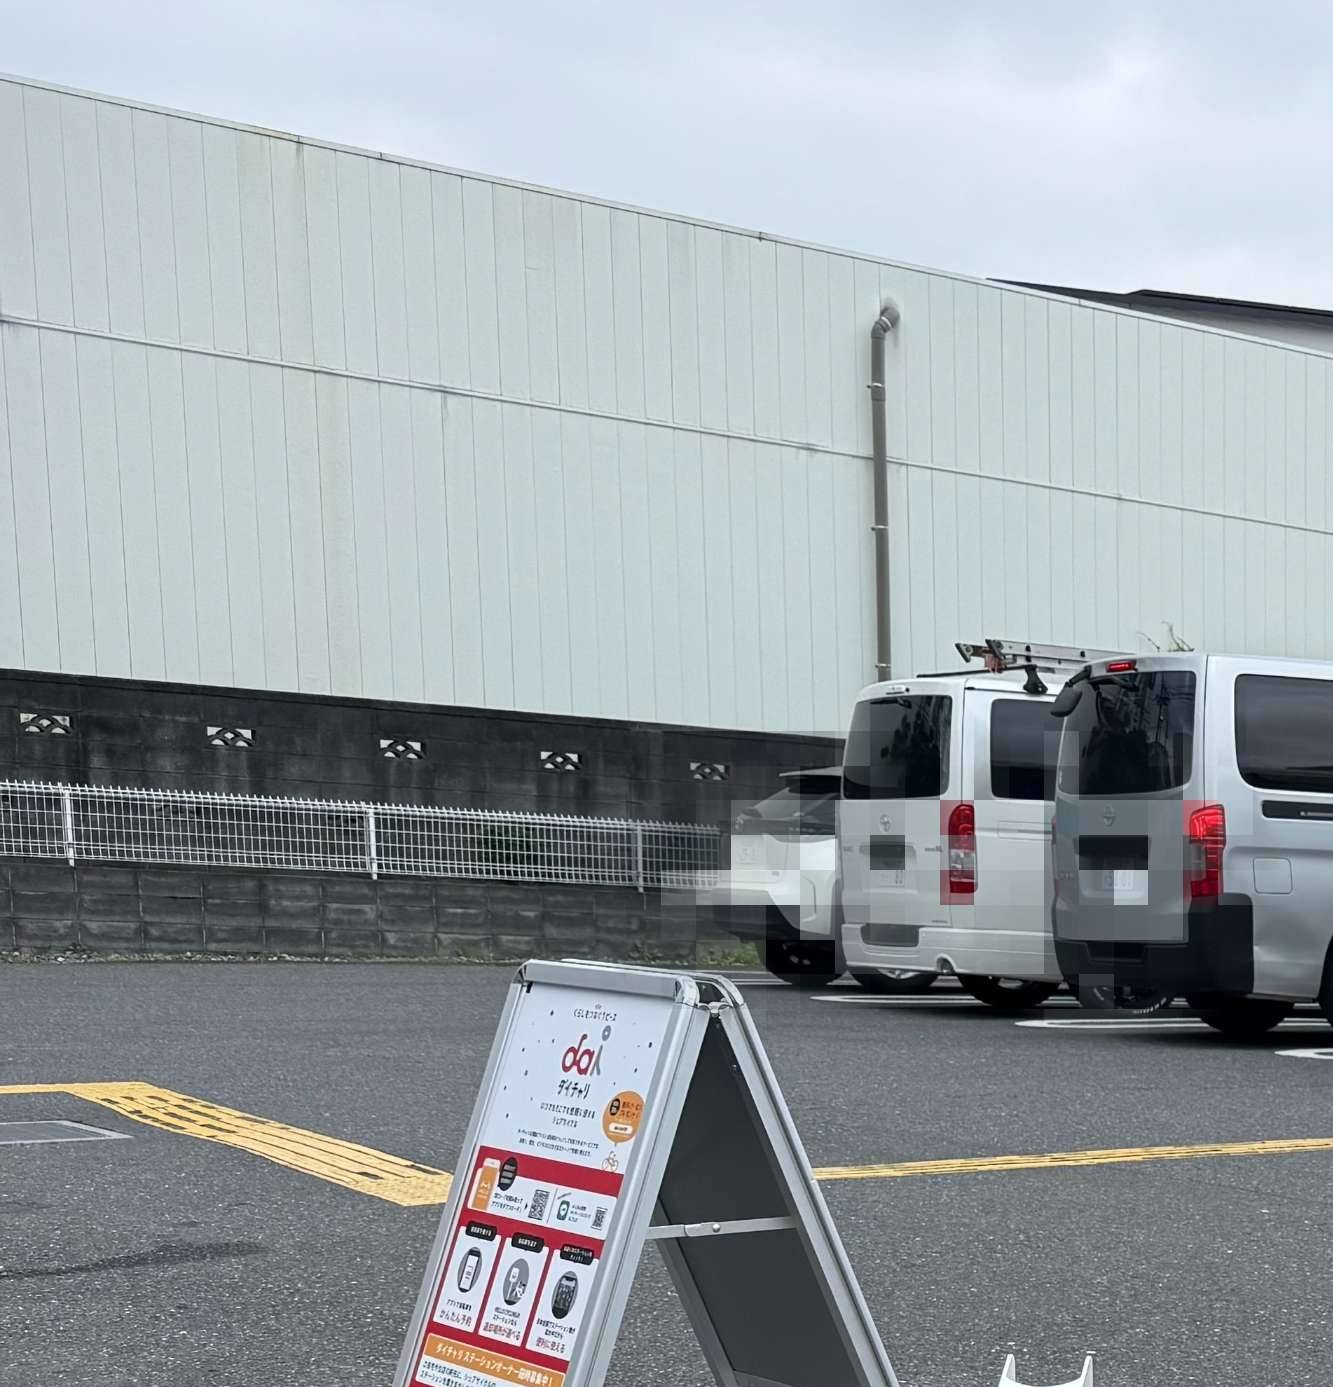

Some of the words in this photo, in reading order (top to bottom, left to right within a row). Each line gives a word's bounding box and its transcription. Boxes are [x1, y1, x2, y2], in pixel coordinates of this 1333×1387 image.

[557, 1079, 590, 1100] ダイチャリ
